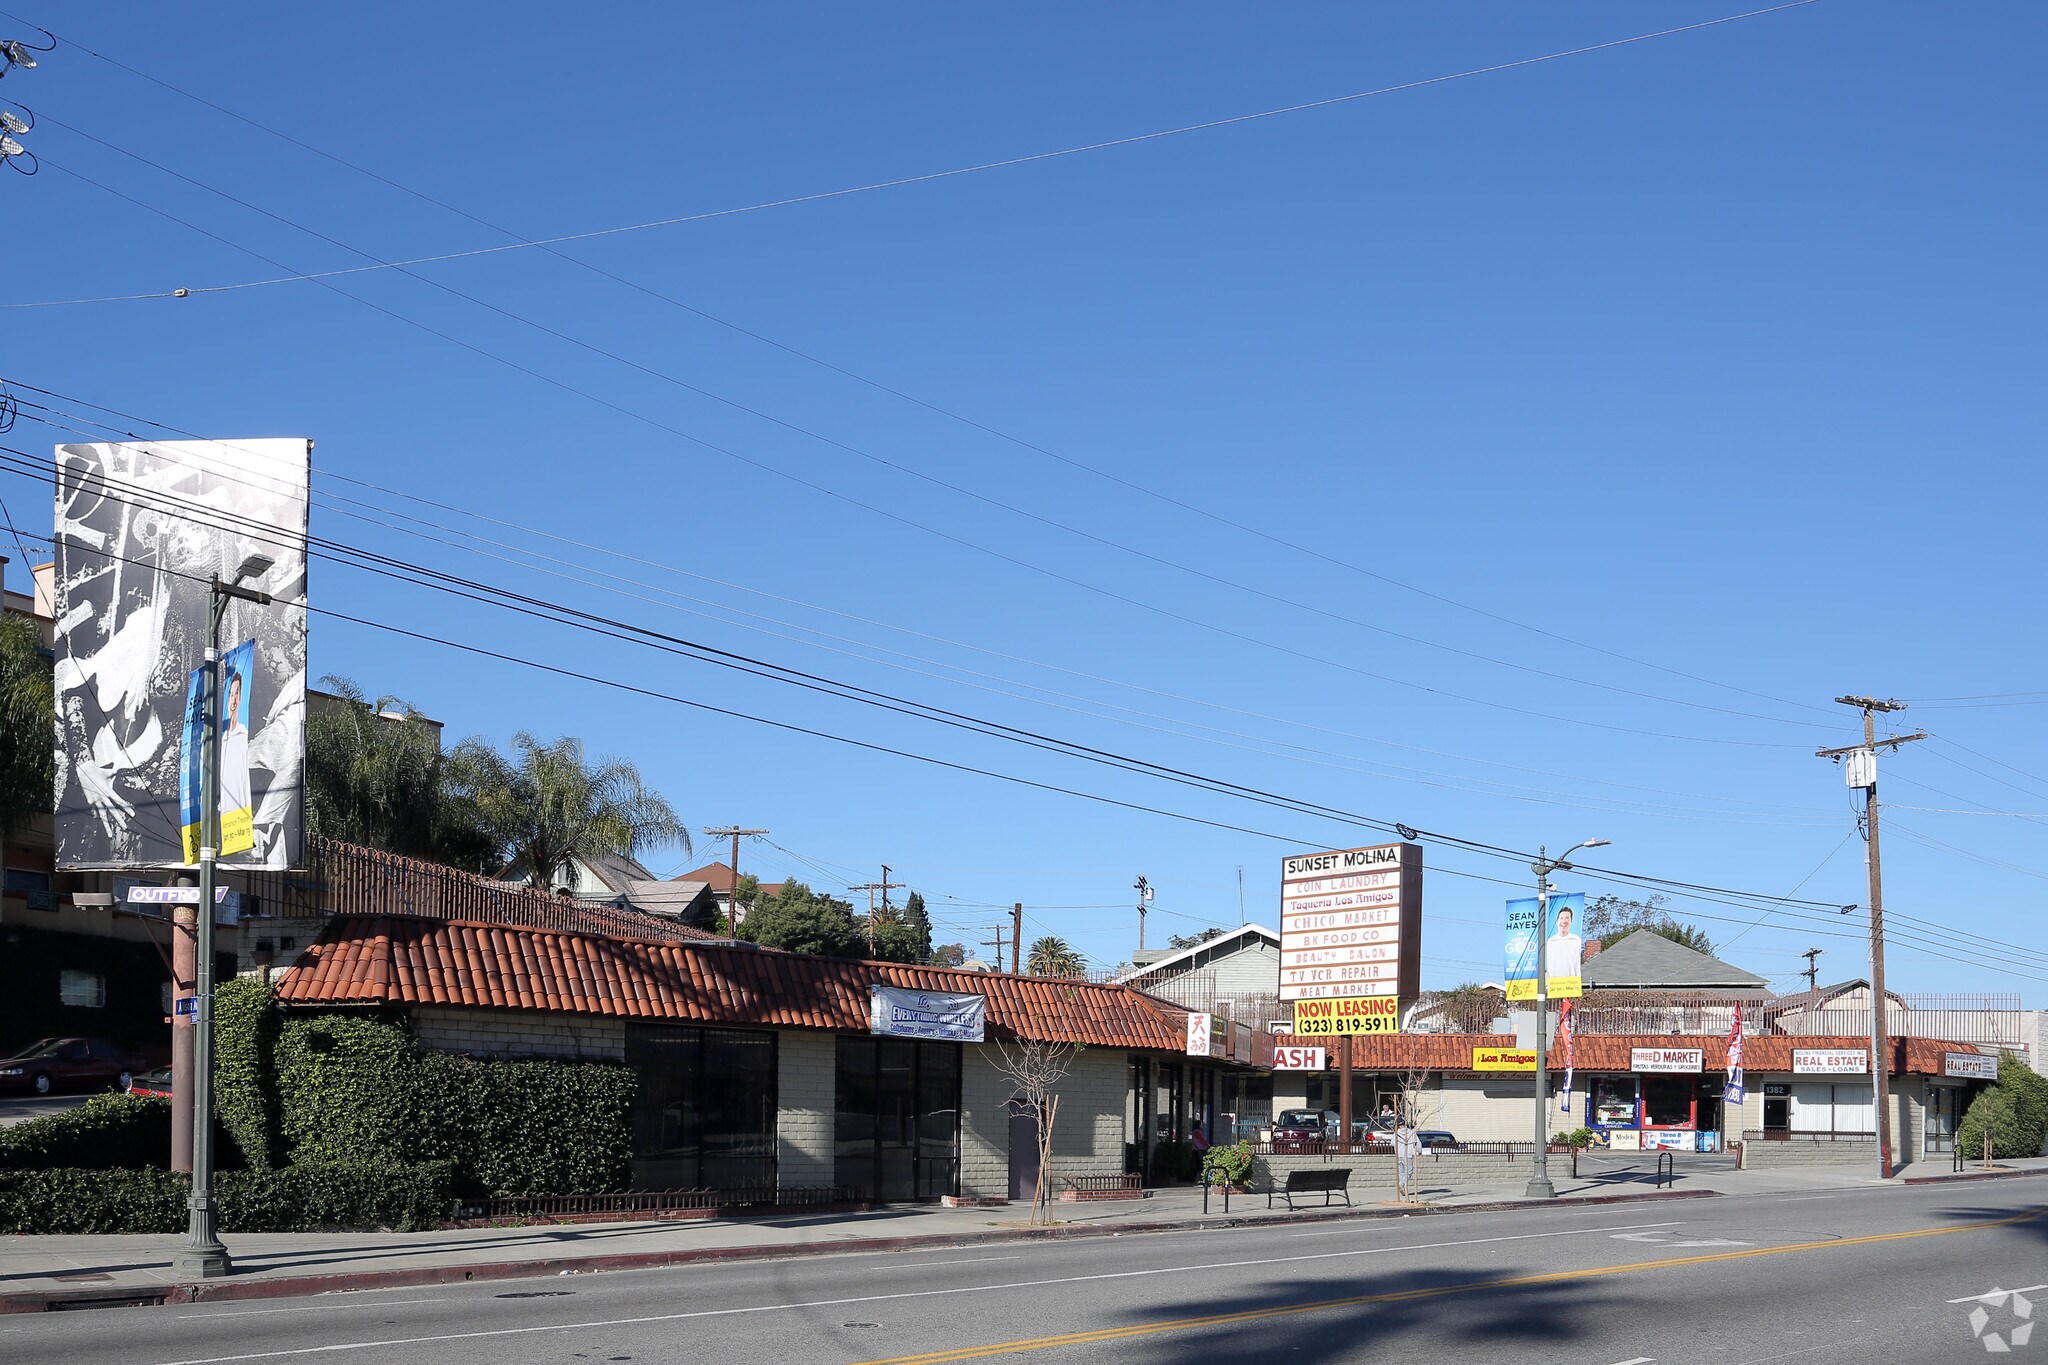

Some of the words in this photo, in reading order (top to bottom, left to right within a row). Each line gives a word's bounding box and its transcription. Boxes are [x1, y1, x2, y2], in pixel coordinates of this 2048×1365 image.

[189, 693, 204, 711] SEA
[185, 707, 205, 728] HAYE
[1288, 855, 1339, 873] SUNSET
[1344, 848, 1397, 867] MOLINA
[1297, 880, 1322, 893] COIN
[1331, 873, 1387, 890] LAUNDRY
[132, 889, 223, 901] OUTFROT
[1290, 899, 1332, 911] Taqueria
[1335, 896, 1353, 906] Los
[1356, 893, 1394, 904] Amigos
[1294, 915, 1335, 929] CHICO
[1344, 910, 1389, 925] MARKET
[1509, 912, 1535, 921] SEAN
[1506, 921, 1538, 930] HAYES
[1304, 936, 1318, 946] BK
[1323, 933, 1357, 944] FOOD
[1363, 930, 1379, 940] CO
[1296, 952, 1337, 964] BEAUTY
[1349, 948, 1386, 960] SALON
[1505, 941, 1537, 955] GOD
[1290, 971, 1305, 982] TV
[1311, 969, 1332, 980] VCR
[1341, 966, 1379, 979] REPAIR
[1300, 986, 1327, 997] MEAT
[1332, 984, 1376, 995] MARKET
[1298, 1001, 1332, 1018] NOW
[1336, 998, 1396, 1016] LEASING
[893, 1006, 938, 1022] EVERYTHING
[940, 1013, 975, 1028] WIRELESS
[1299, 1018, 1333, 1034] (323)
[1336, 1017, 1396, 1032] 819-5911
[1274, 1049, 1316, 1068] ASH
[1481, 1054, 1498, 1062] Los
[1500, 1054, 1536, 1064] Amigos
[1663, 1052, 1700, 1063] MARKET
[1795, 1056, 1823, 1066] REAL
[1827, 1056, 1866, 1066] ESTATE
[1947, 1060, 1961, 1070] REAL
[1962, 1061, 1981, 1072] ESTATE
[1766, 1086, 1784, 1094] 1382
